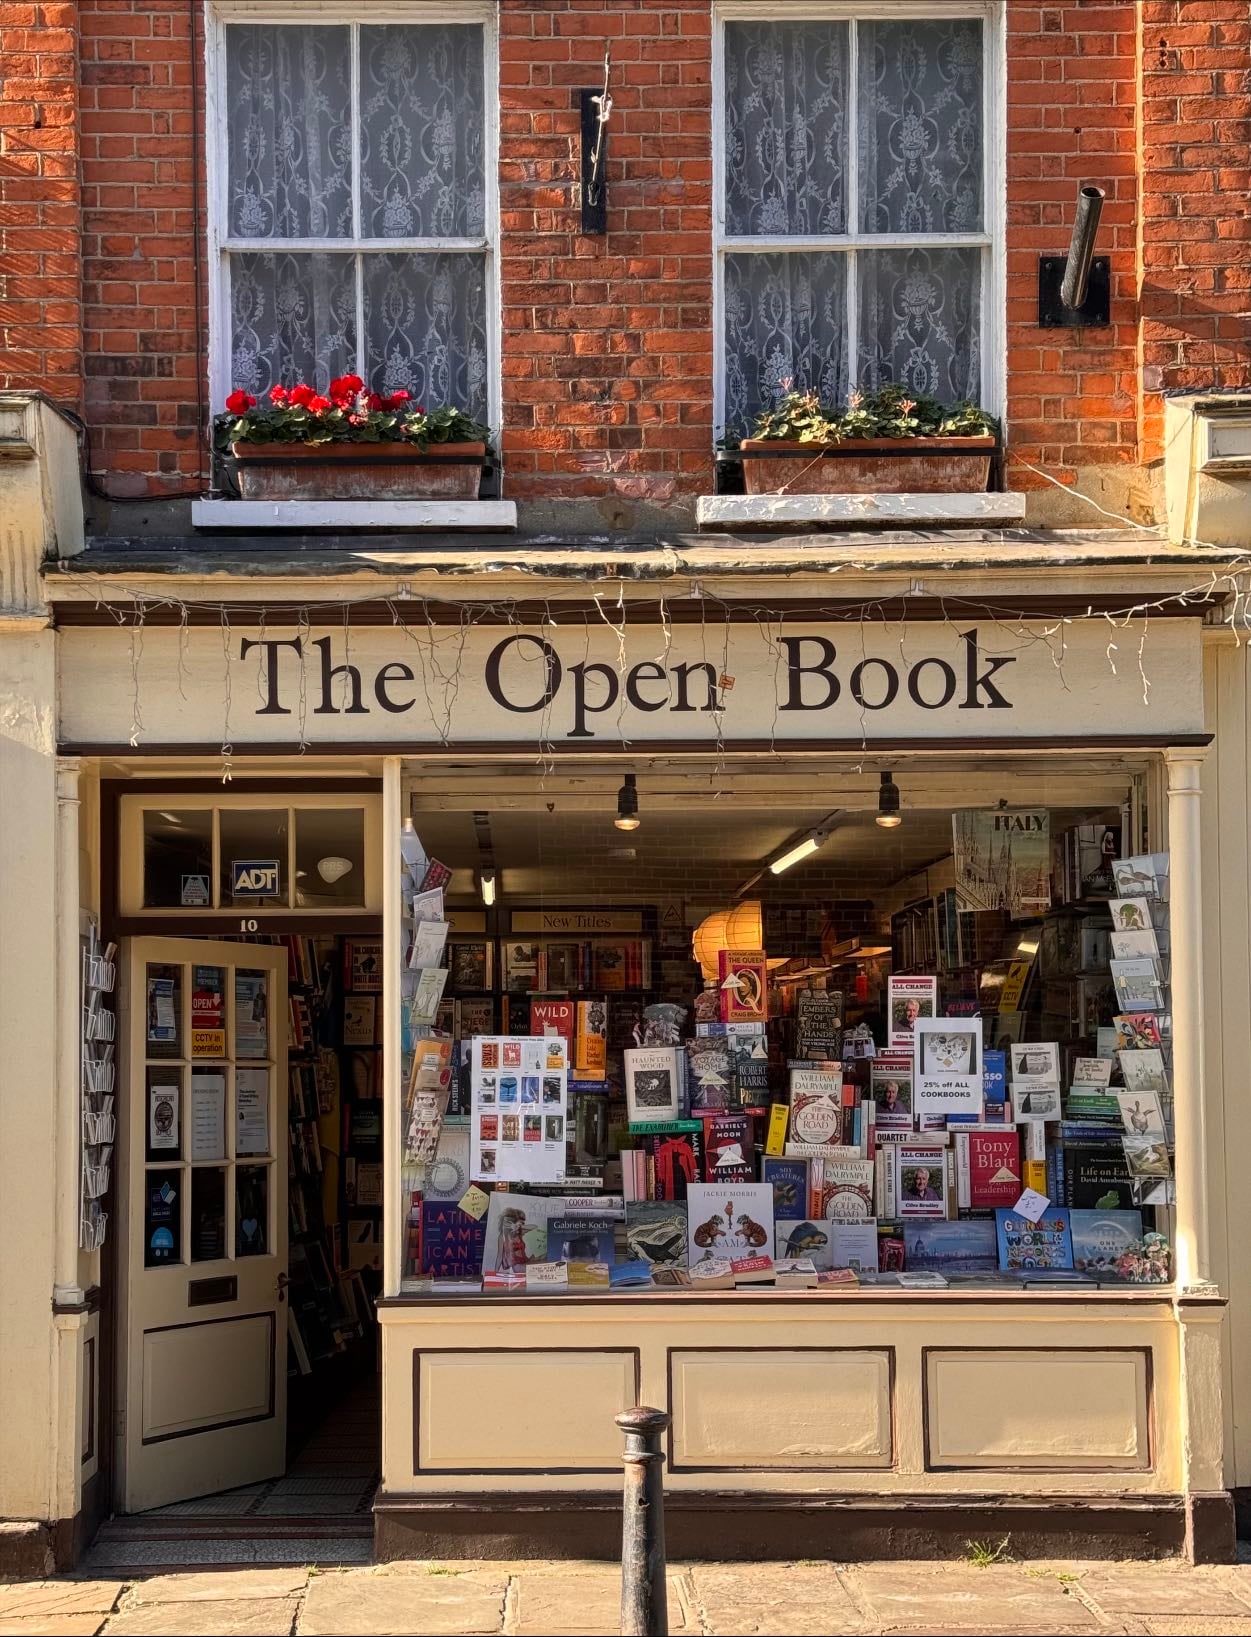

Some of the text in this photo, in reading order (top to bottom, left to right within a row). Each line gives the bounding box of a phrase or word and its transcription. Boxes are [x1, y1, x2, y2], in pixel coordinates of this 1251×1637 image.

[240, 628, 1017, 737] The Open Book
[994, 815, 1047, 832] ITALY
[234, 868, 276, 890] ADT
[239, 919, 258, 932] 10
[543, 915, 612, 928] New Titles
[192, 998, 212, 1009] OPEN
[534, 1007, 569, 1018] WILD
[803, 1005, 836, 1013] EMBERS
[195, 1034, 221, 1043] CCTV in
[193, 1043, 223, 1053] operation
[632, 1056, 671, 1064] HAUNTED
[693, 1056, 726, 1064] VOYAGE
[740, 1065, 767, 1076] ROBERT
[740, 1076, 768, 1087] HARRIS
[800, 1074, 834, 1082] WILLIAM
[795, 1082, 838, 1091] DALRYMPLE
[799, 1112, 834, 1121] GOLDEN
[710, 1122, 747, 1130] GABRIEL'S
[803, 1120, 829, 1129] ROAD
[877, 1133, 907, 1142] QUARTET
[691, 1133, 700, 1157] MARK
[973, 1138, 1013, 1153] Tony
[978, 1154, 1016, 1168] Blair
[831, 1163, 865, 1172] WILLIAM
[1080, 1167, 1098, 1175] Life
[1113, 1167, 1129, 1176] Ear
[825, 1171, 870, 1180] DALRYMPLE
[973, 1185, 1017, 1195] Leadership
[568, 1198, 593, 1206] COOPER
[829, 1201, 863, 1210] GOLDEN
[427, 1210, 476, 1225] LATIN
[833, 1209, 859, 1217] ROAD
[553, 1220, 608, 1230] Gabriele Koch
[1003, 1220, 1066, 1232] GUINNESS
[445, 1229, 481, 1241] AME
[1005, 1233, 1064, 1246] WORLD
[427, 1244, 468, 1259] ICAN
[1006, 1246, 1066, 1258] RECORDS
